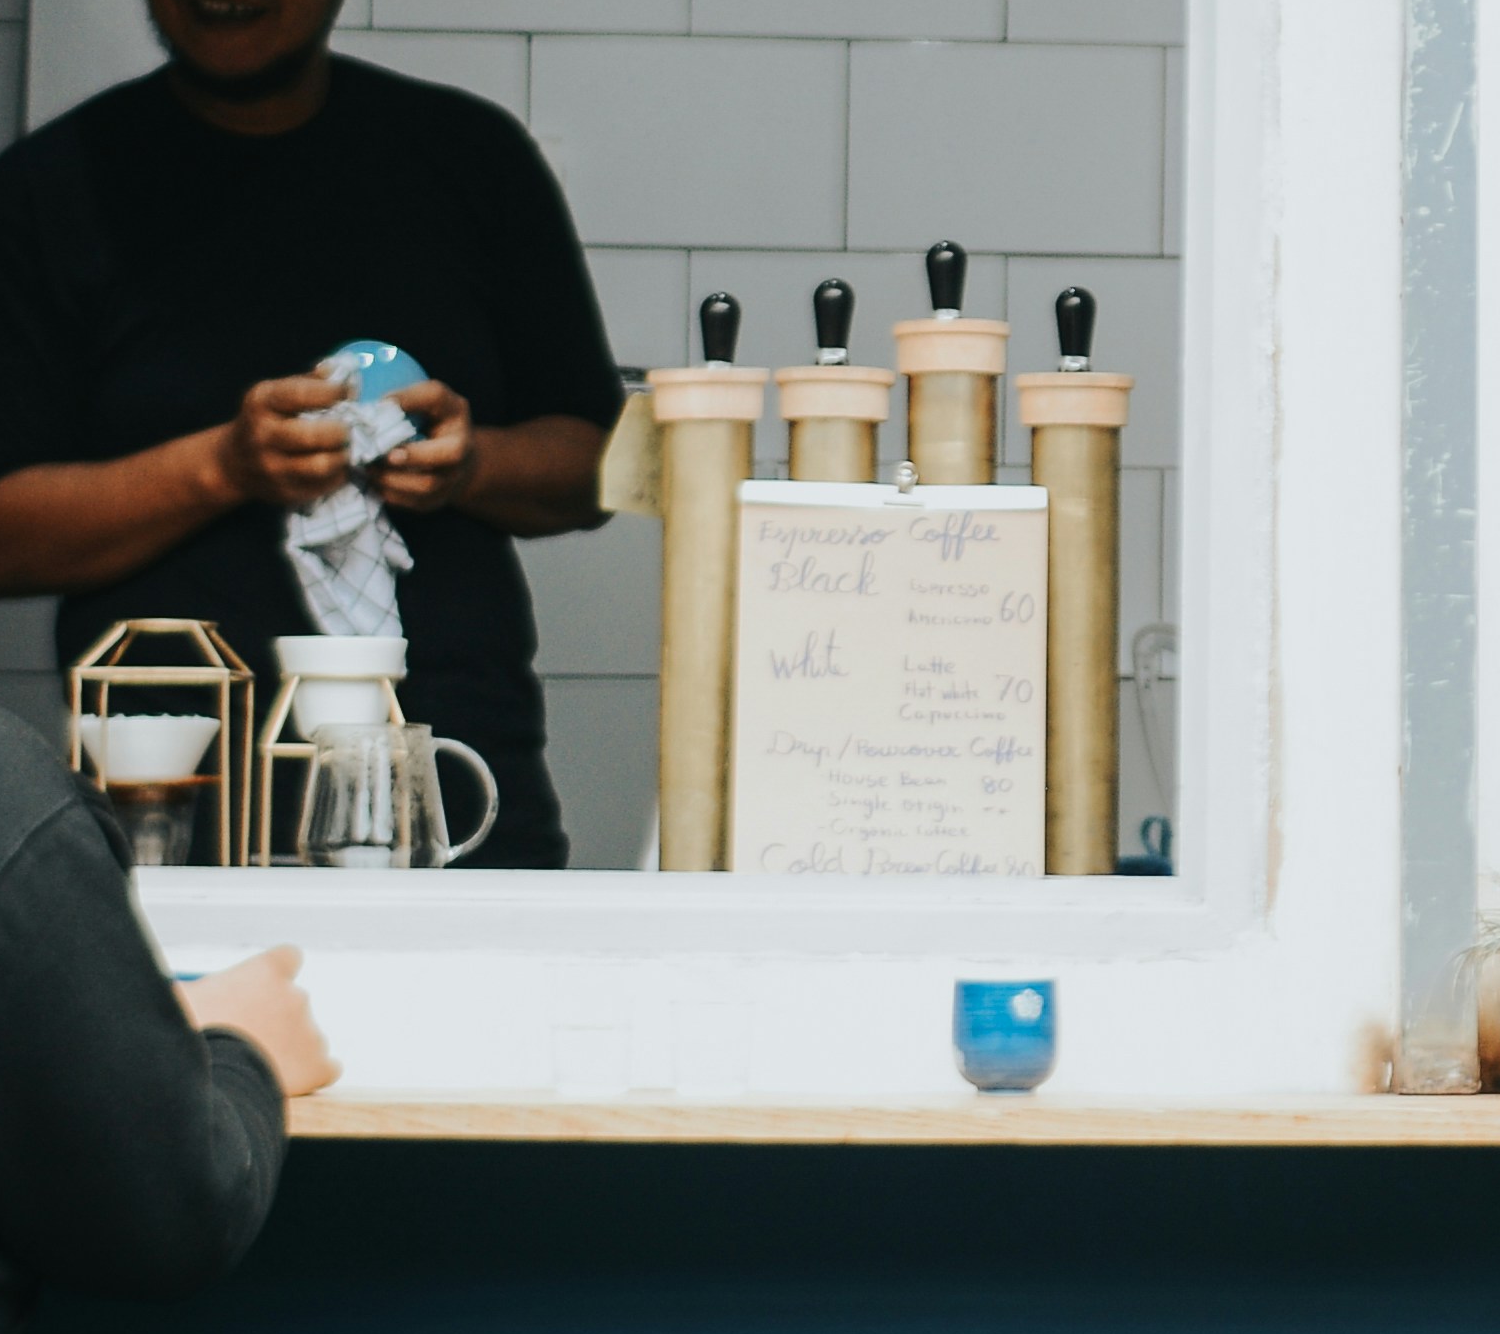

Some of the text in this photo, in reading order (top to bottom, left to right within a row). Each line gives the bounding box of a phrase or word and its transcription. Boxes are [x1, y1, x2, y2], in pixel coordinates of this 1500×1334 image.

[908, 511, 1001, 561] Coffee
[769, 550, 880, 596] Black
[999, 591, 1035, 624] 60
[995, 674, 1033, 703] 70
